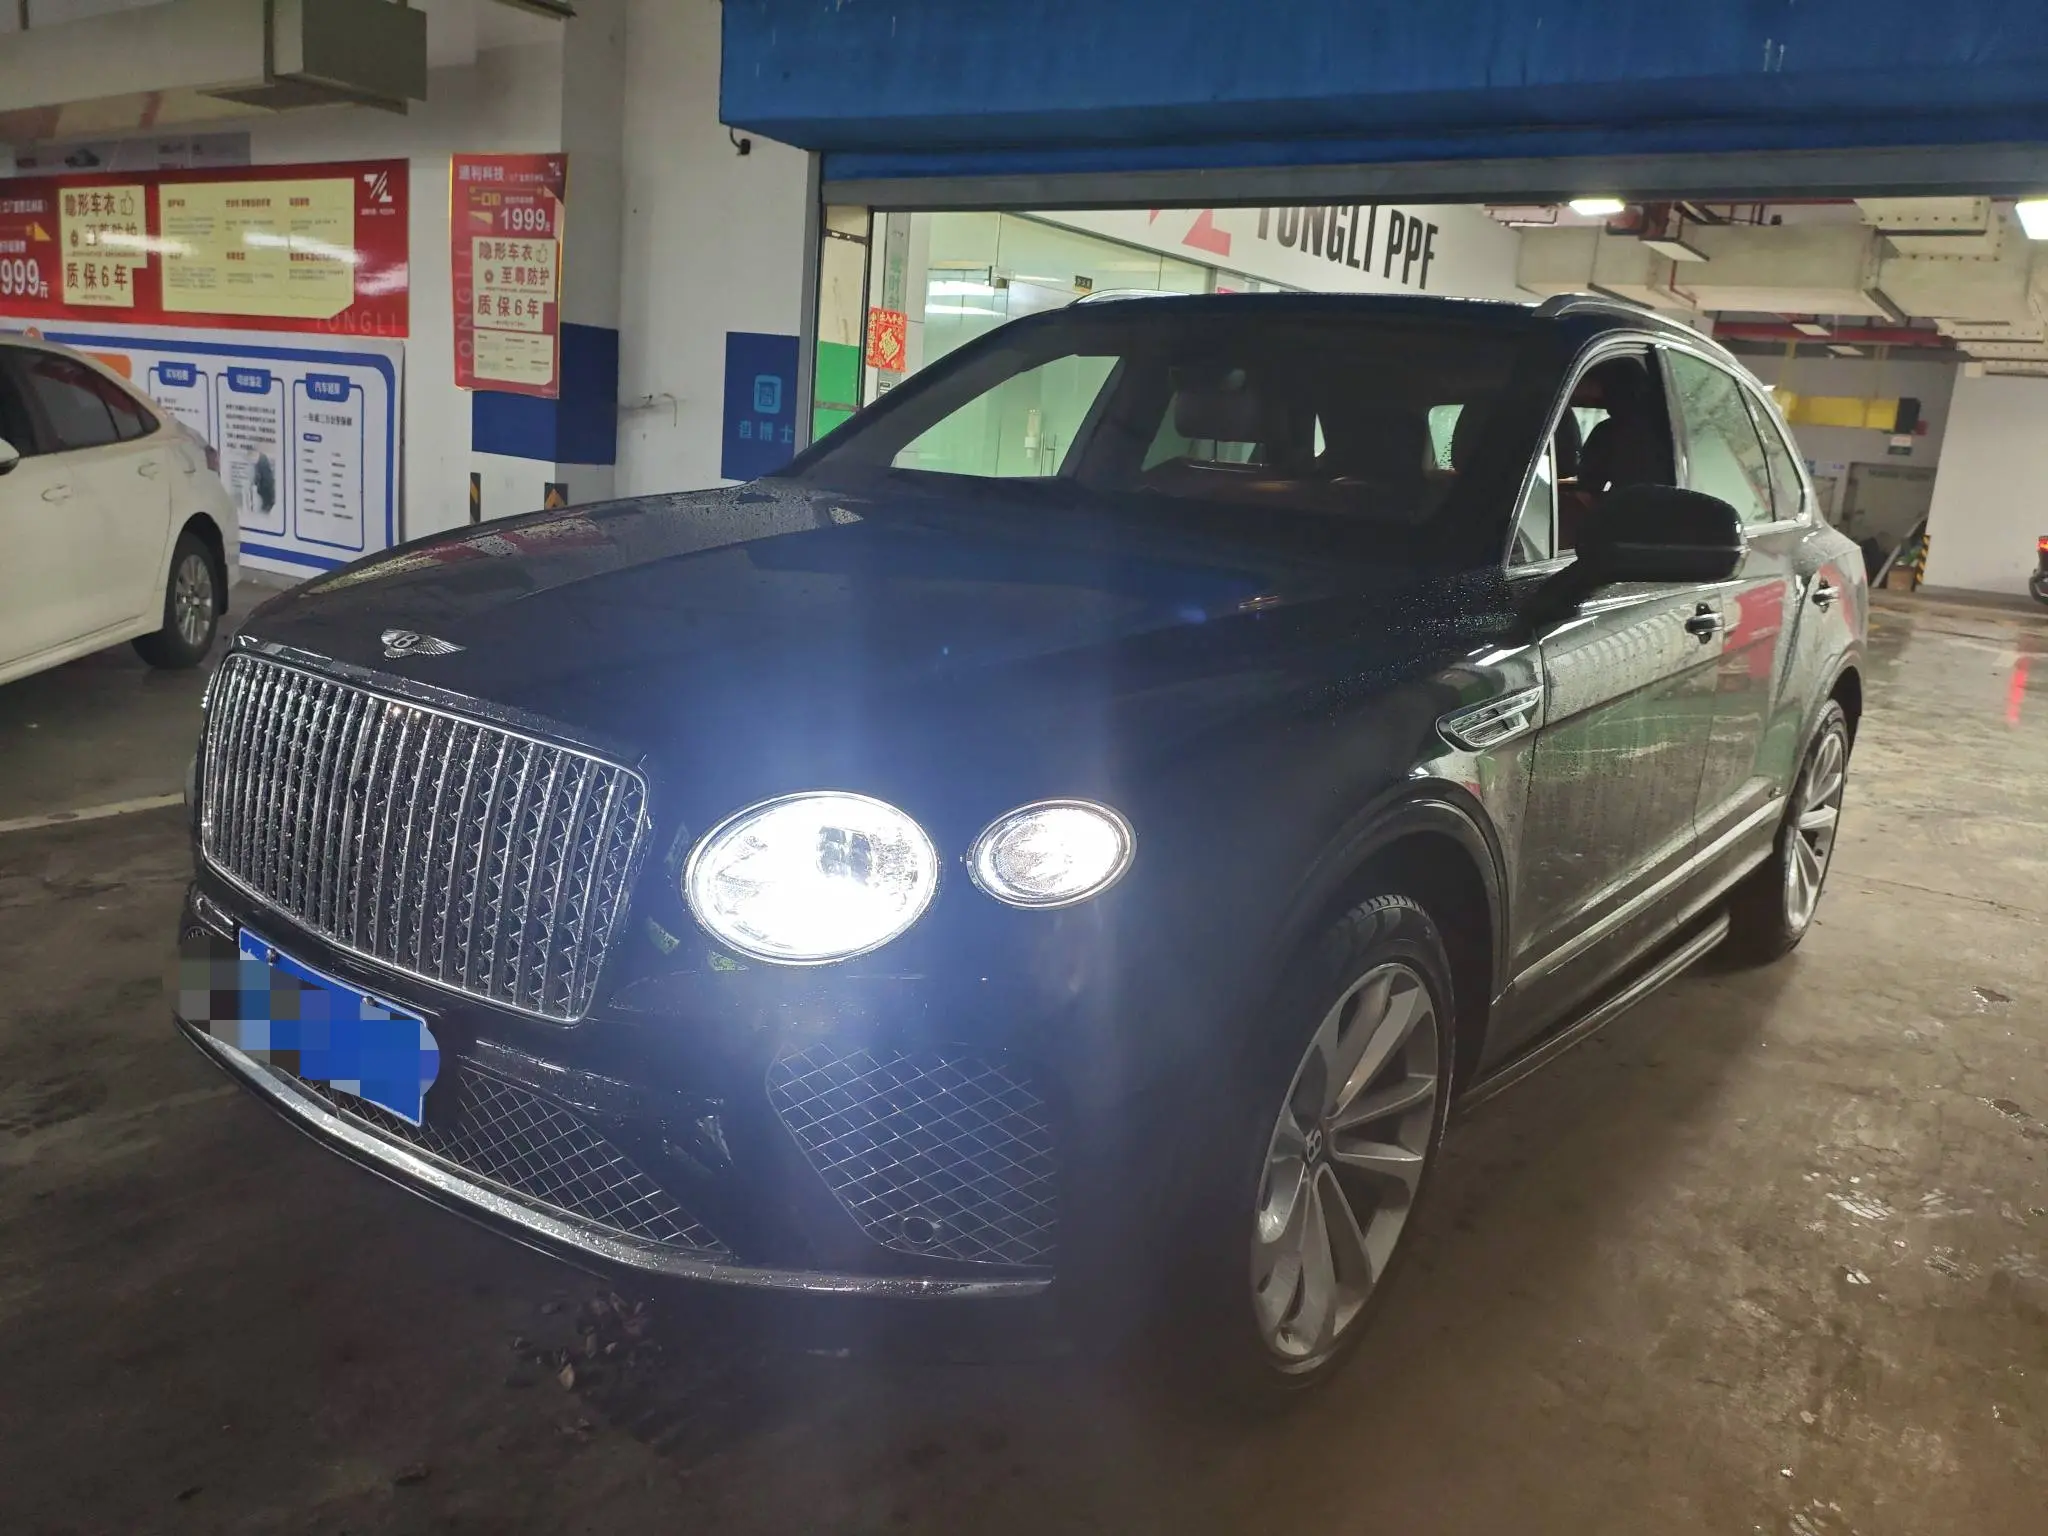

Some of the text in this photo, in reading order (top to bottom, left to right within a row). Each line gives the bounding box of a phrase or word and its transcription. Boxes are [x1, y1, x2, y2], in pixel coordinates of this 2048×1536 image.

[478, 241, 533, 263] 隐形车衣
[1383, 208, 1439, 291] PPF
[66, 262, 128, 292] 质保6年
[501, 266, 550, 286] 至尊防护
[477, 294, 539, 320] 质保6年
[317, 309, 396, 335] ONGLI
[736, 420, 794, 444] 查博士
